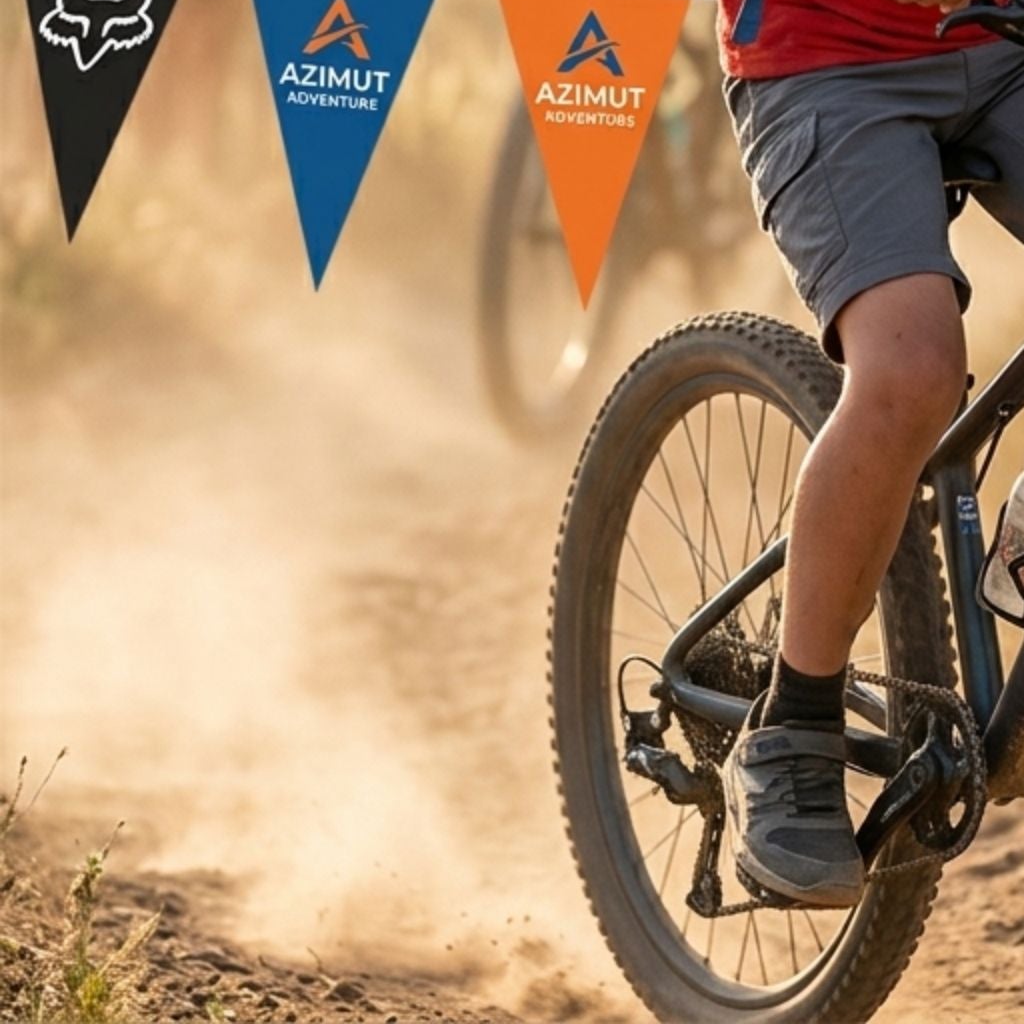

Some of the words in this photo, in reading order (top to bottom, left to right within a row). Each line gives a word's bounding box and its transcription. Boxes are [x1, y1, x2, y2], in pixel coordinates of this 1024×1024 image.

[279, 62, 391, 93] AZIMUT
[287, 91, 379, 111] ADVENTURE
[534, 81, 646, 109] AZIMUT
